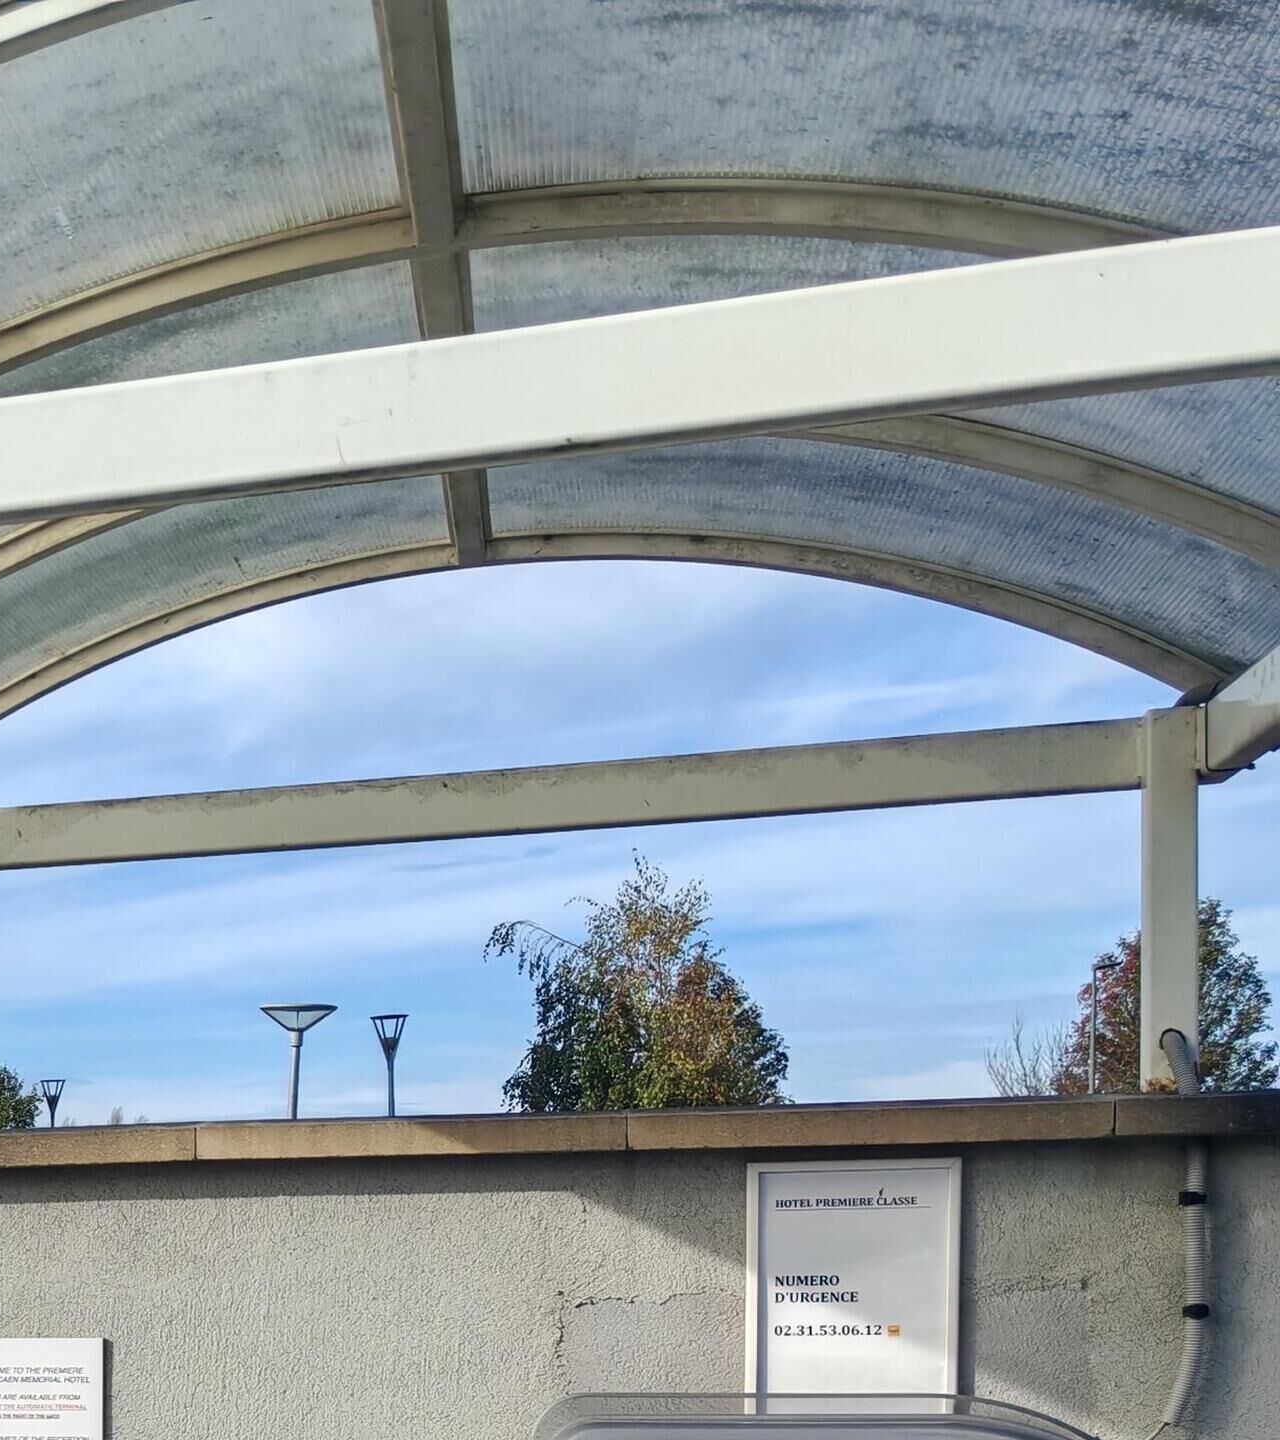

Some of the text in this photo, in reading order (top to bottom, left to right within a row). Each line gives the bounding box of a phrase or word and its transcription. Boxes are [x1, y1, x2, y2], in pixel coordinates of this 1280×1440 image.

[775, 1196, 918, 1209] HOTEL PREMIERE CLASSE
[775, 1275, 840, 1287] NUMERO
[775, 1291, 859, 1304] D'URGENCE
[774, 1324, 882, 1337] 02.31.53.06.12
[42, 1367, 85, 1375] PREMIERE
[20, 1376, 61, 1384] MEMORIAL
[63, 1376, 91, 1384] HOTEL
